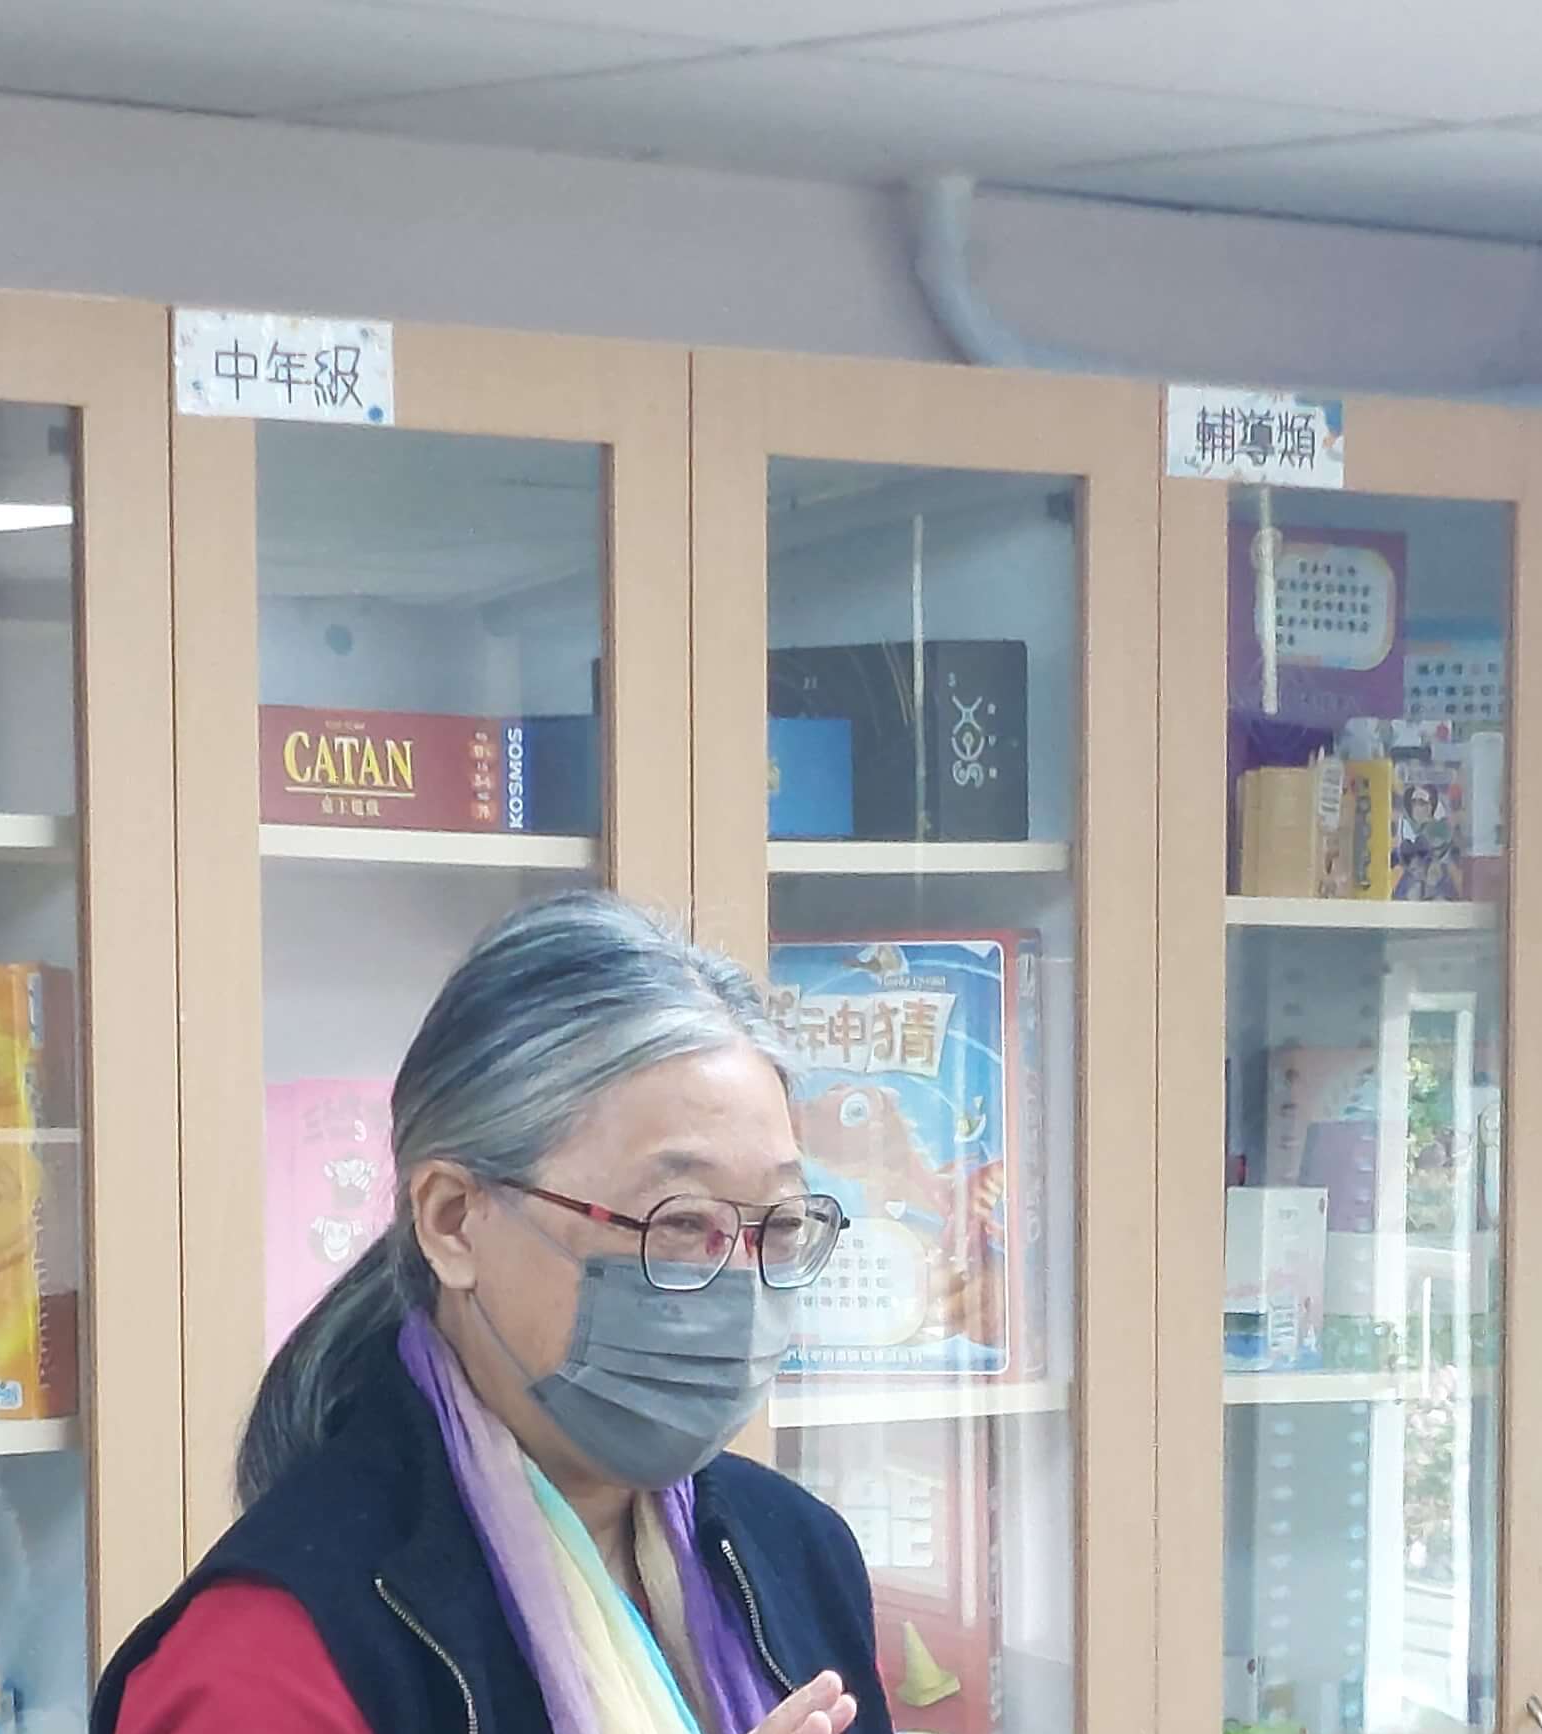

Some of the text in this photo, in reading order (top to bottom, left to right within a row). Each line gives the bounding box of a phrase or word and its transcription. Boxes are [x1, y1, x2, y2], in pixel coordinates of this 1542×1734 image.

[215, 338, 363, 408] 中年級
[282, 731, 414, 789] CATAN
[508, 727, 524, 829] KOSMOS
